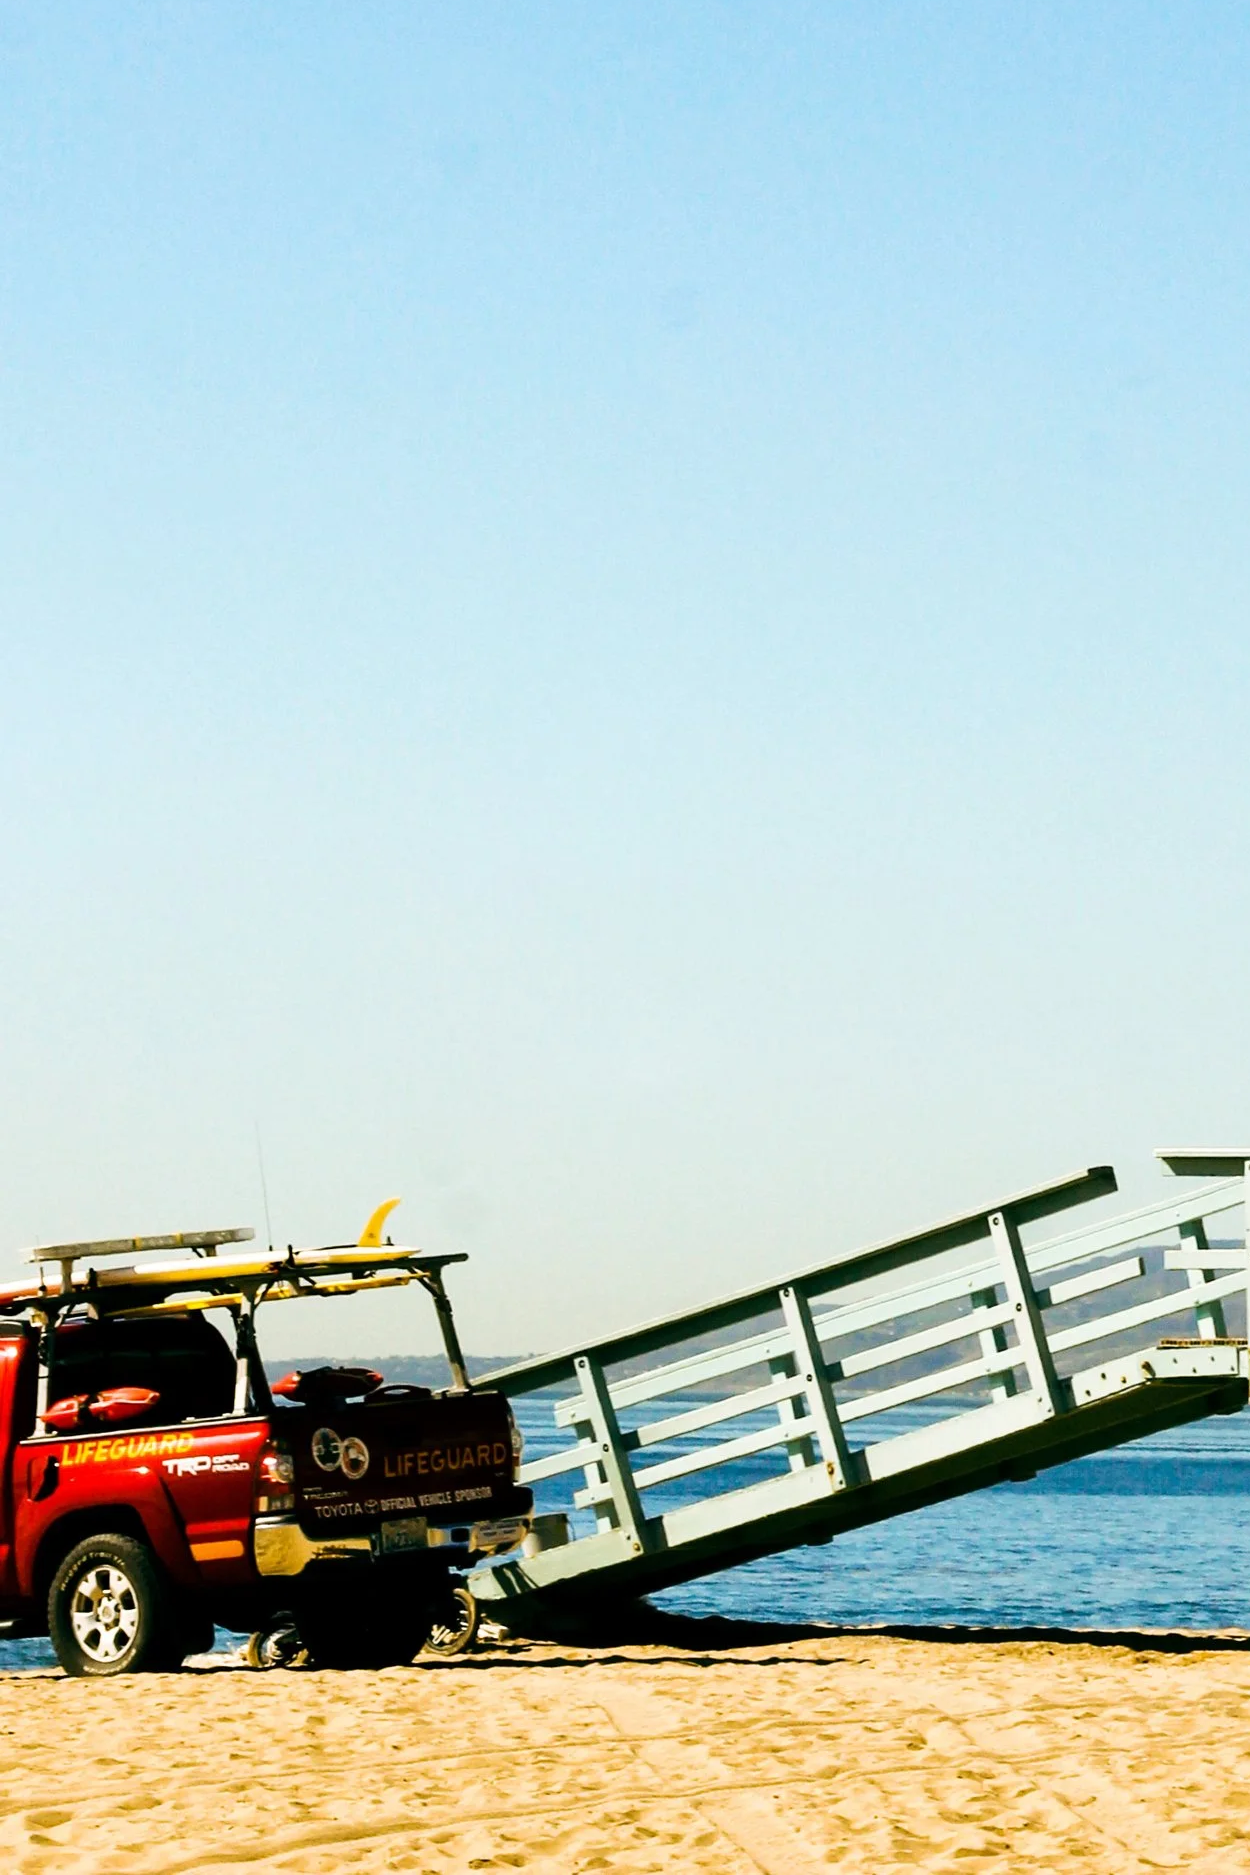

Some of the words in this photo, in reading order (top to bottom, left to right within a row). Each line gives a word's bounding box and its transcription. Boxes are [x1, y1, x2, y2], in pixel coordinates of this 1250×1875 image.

[61, 1432, 196, 1467] LIFEGUARD
[211, 1454, 240, 1464] OFF
[383, 1442, 508, 1479] LIFEGUARD
[162, 1456, 211, 1476] TRD
[211, 1462, 250, 1473] ROAD
[314, 1502, 364, 1518] TOYOTA
[380, 1496, 417, 1512] OFFICIAL
[419, 1491, 453, 1507] VEHICLE
[453, 1486, 493, 1503] SPONSOR
